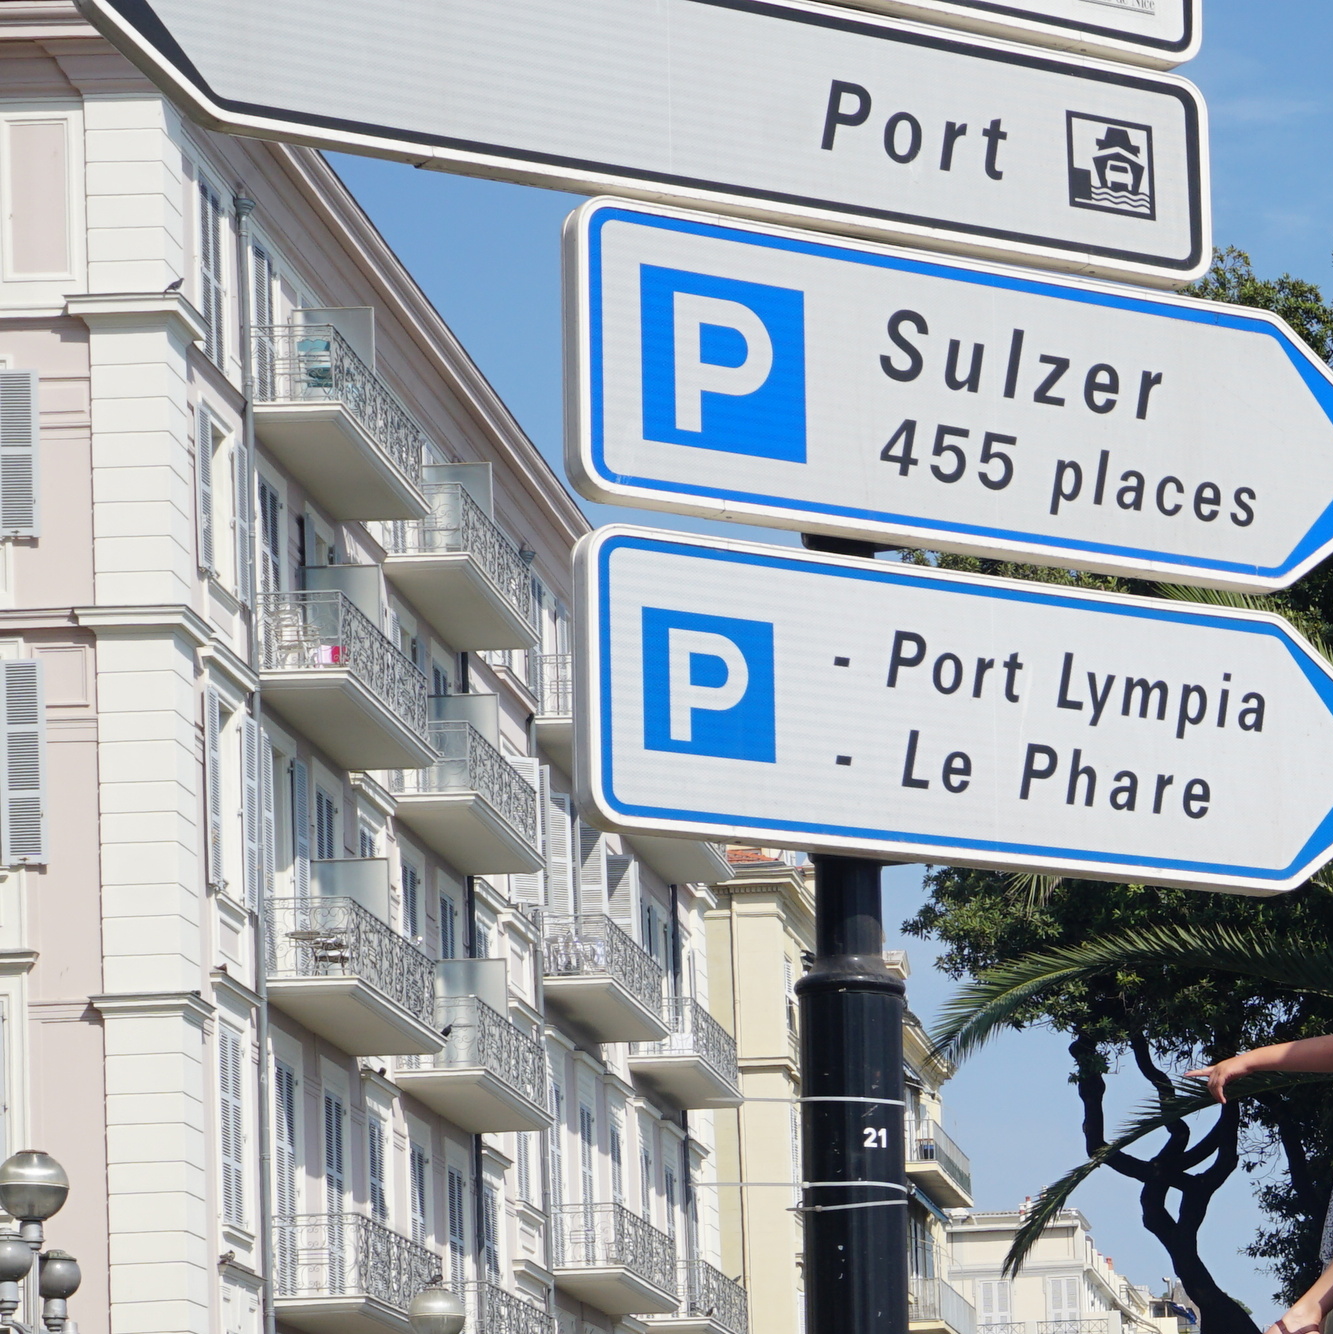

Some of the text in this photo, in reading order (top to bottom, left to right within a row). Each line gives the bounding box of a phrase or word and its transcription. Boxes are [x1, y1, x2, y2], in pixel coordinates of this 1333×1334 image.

[821, 79, 1008, 181] Port
[879, 309, 1163, 420] Sulzer
[880, 419, 1256, 527] 455 places
[886, 630, 1023, 703] Port
[1057, 652, 1265, 739] Lympia
[902, 729, 972, 794] Le
[1019, 743, 1211, 819] Phare
[863, 1127, 887, 1149] 21
